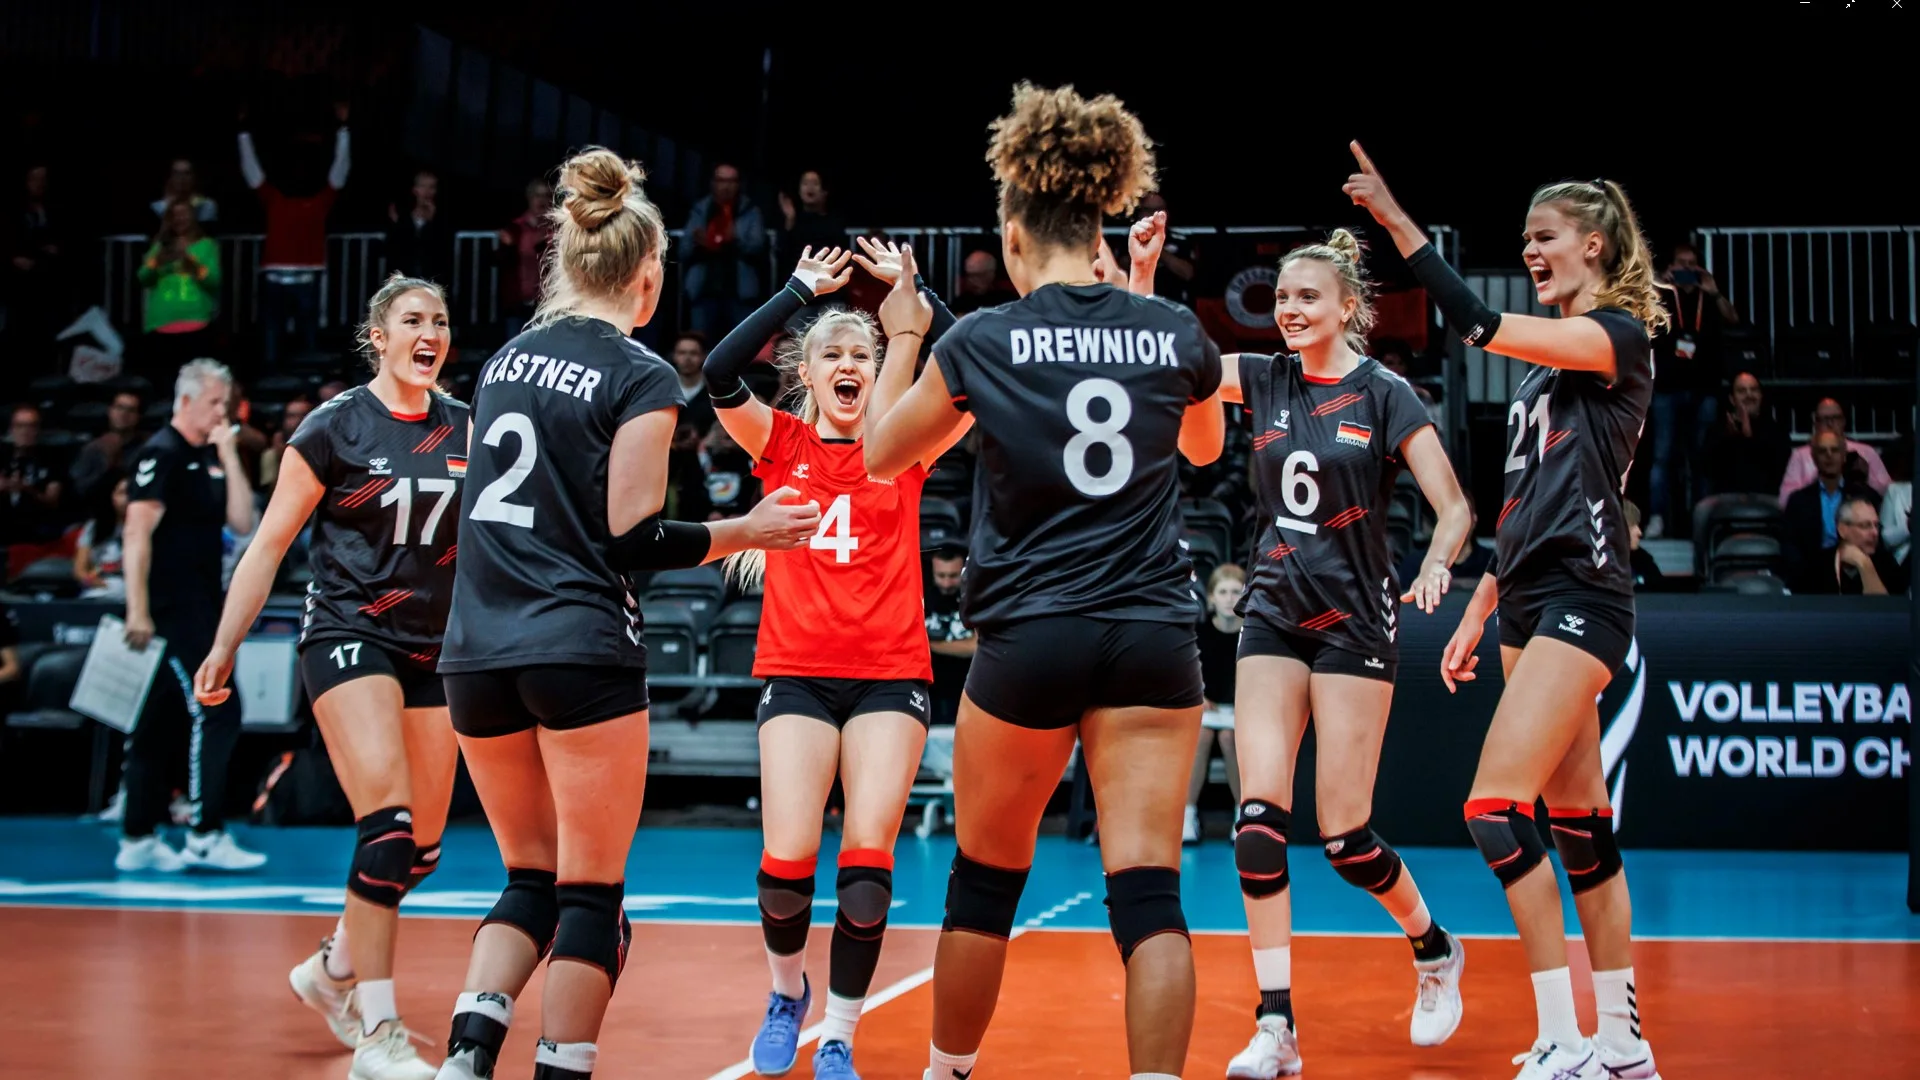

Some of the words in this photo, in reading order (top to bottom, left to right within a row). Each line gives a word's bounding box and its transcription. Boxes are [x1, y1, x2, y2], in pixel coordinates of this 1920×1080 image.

[482, 347, 602, 402] KÄSTNER
[1010, 327, 1179, 367] DREWNIOK
[1063, 377, 1133, 496] 8
[1335, 435, 1369, 450] GERMANY
[1504, 393, 1551, 474] 21
[469, 412, 537, 529] 2
[1281, 450, 1320, 517] 6
[380, 477, 457, 546] 17
[809, 494, 859, 564] 4
[329, 641, 363, 669] 17
[761, 683, 773, 706] 4
[1667, 680, 1911, 724] VOLLEYBA
[1667, 735, 1846, 778] WORLD
